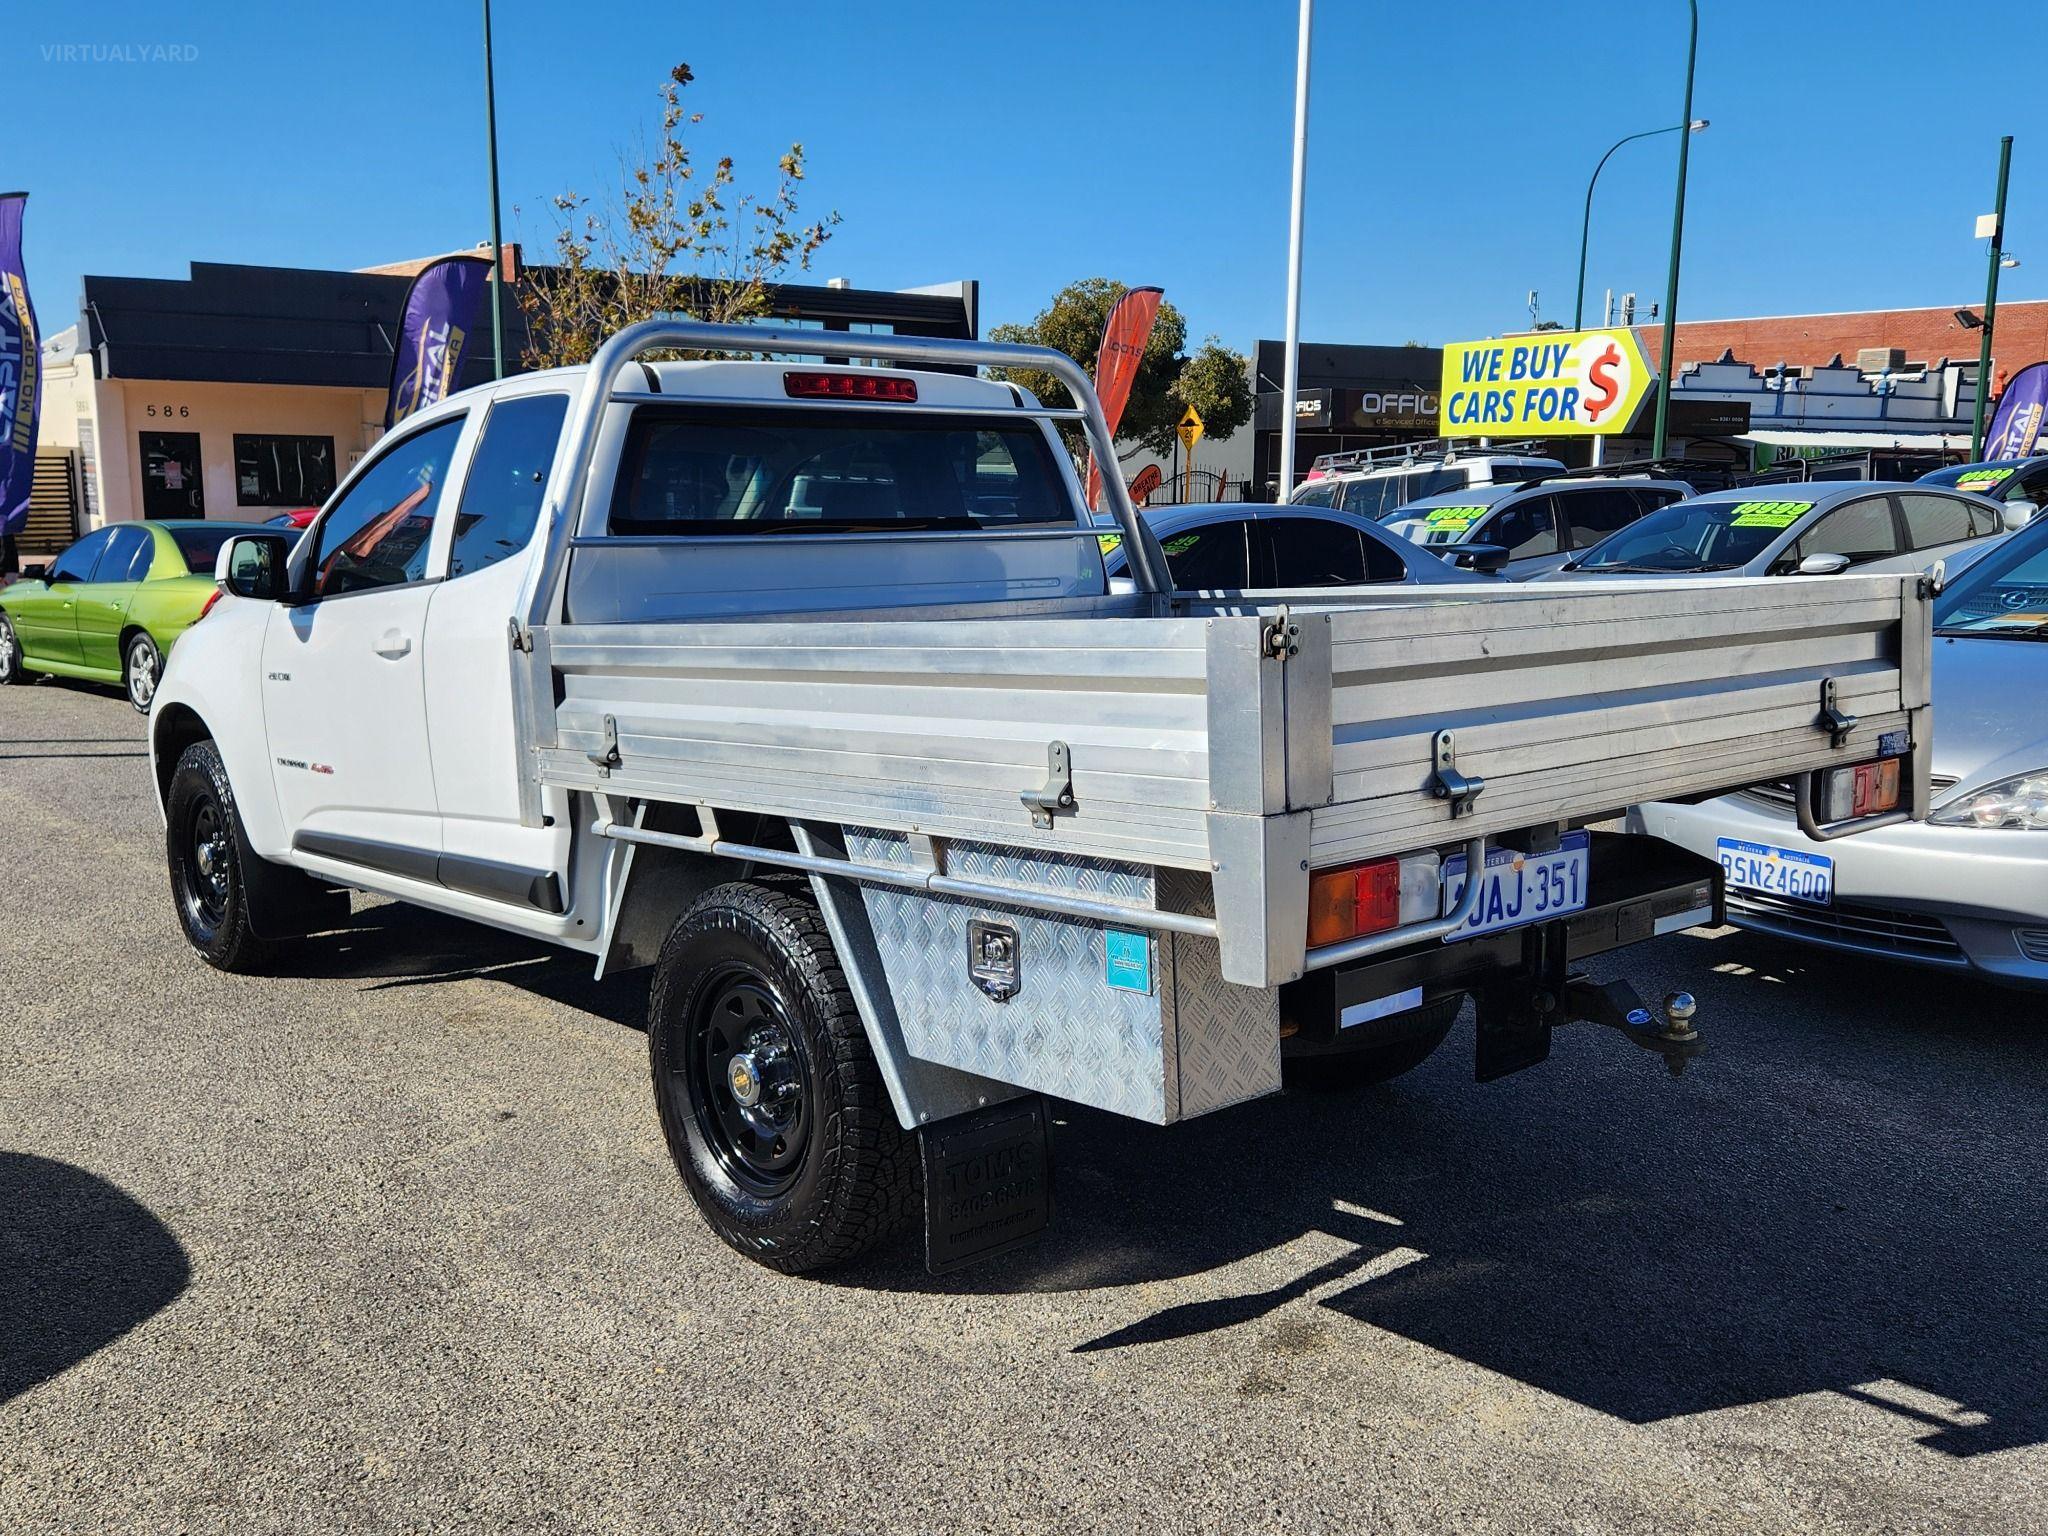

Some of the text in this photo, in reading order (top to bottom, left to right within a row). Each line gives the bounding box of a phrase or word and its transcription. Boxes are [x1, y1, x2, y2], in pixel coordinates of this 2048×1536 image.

[1462, 343, 1572, 383] WE BUY
[147, 405, 190, 418] 586
[1362, 393, 1440, 415] OFFIC
[1448, 389, 1516, 424] CARS
[1522, 387, 1579, 422] FOR
[1133, 470, 1159, 495] BREATHE
[1738, 845, 1811, 863] WESTERN AUSTRALIA
[1720, 853, 1827, 901] BSN24600
